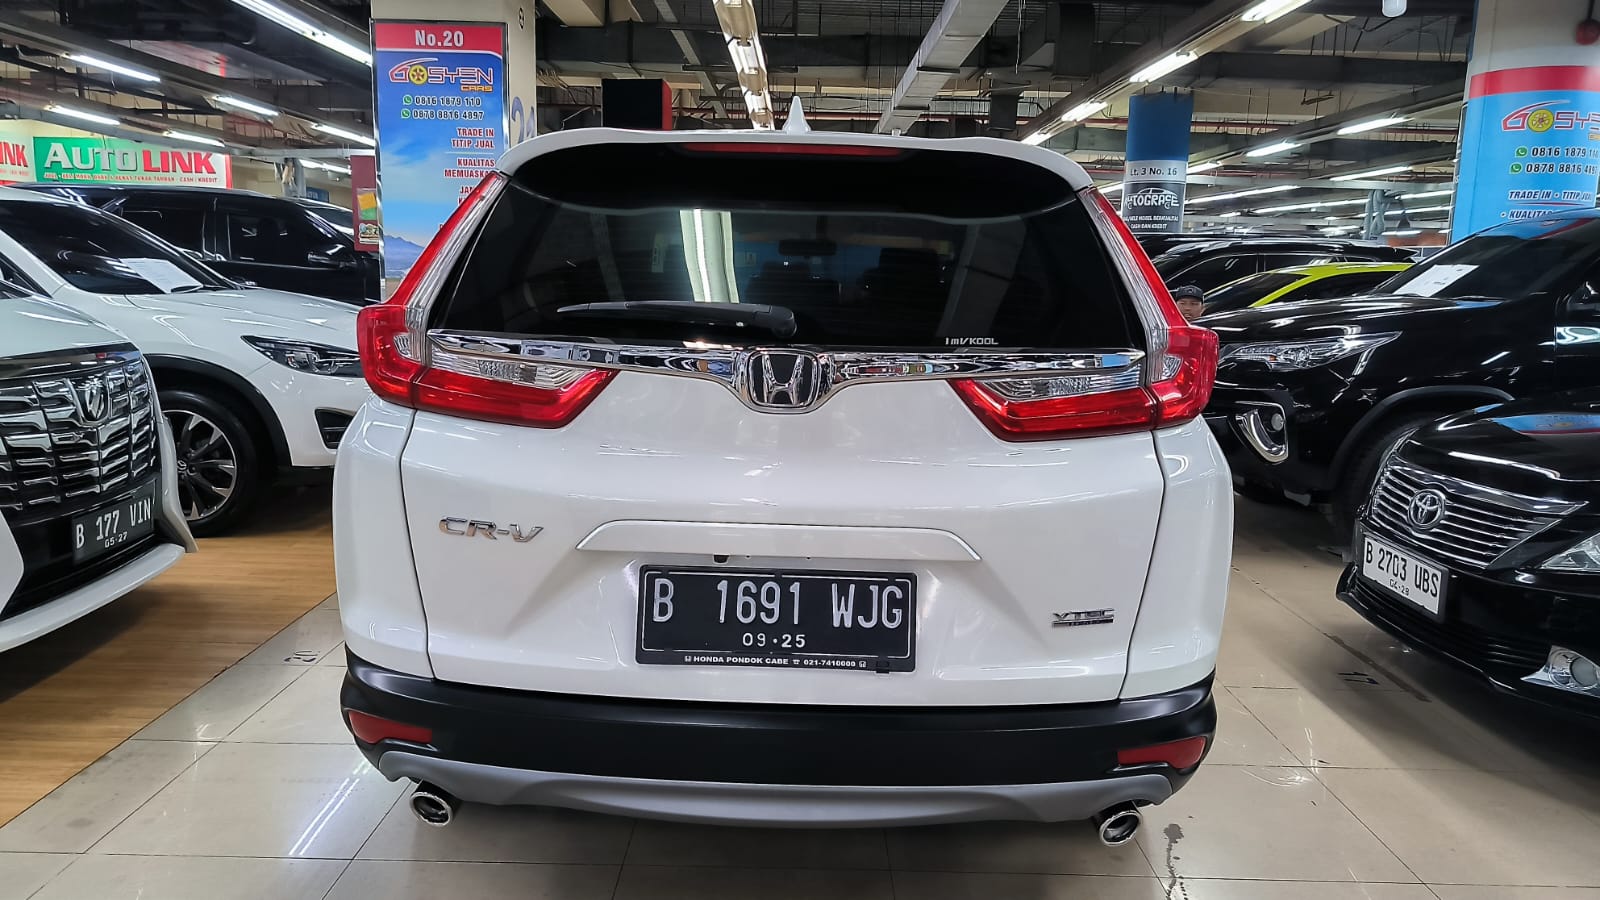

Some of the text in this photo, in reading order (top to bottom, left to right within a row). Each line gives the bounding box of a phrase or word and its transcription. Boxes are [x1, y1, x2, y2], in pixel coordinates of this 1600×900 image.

[414, 29, 464, 47] No.20
[415, 95, 482, 106] 0816 1879 110
[412, 109, 484, 120] 0878 8816 4897
[456, 128, 495, 137] TRADE IN
[452, 138, 495, 149] TITIP JUAL
[1531, 147, 1560, 157] 0816
[1565, 147, 1586, 158] 1879
[44, 143, 216, 174] AUTO LINK
[457, 158, 495, 168] KUALITAS
[1141, 167, 1147, 176] 3
[1149, 167, 1164, 175] No.
[1168, 168, 1178, 176] 16
[1526, 163, 1555, 173] 0878
[1558, 164, 1582, 174] 8816
[1509, 190, 1539, 200] TRADE
[1541, 190, 1552, 199] IN
[1562, 191, 1581, 200] TITIP
[76, 497, 151, 549] B 177 VIN
[438, 516, 545, 543] CR-V
[1366, 541, 1439, 598] B 2703 UBS
[652, 578, 904, 629] B 1691 WJG
[693, 656, 724, 664] HONDA
[726, 656, 763, 664] PONDOK
